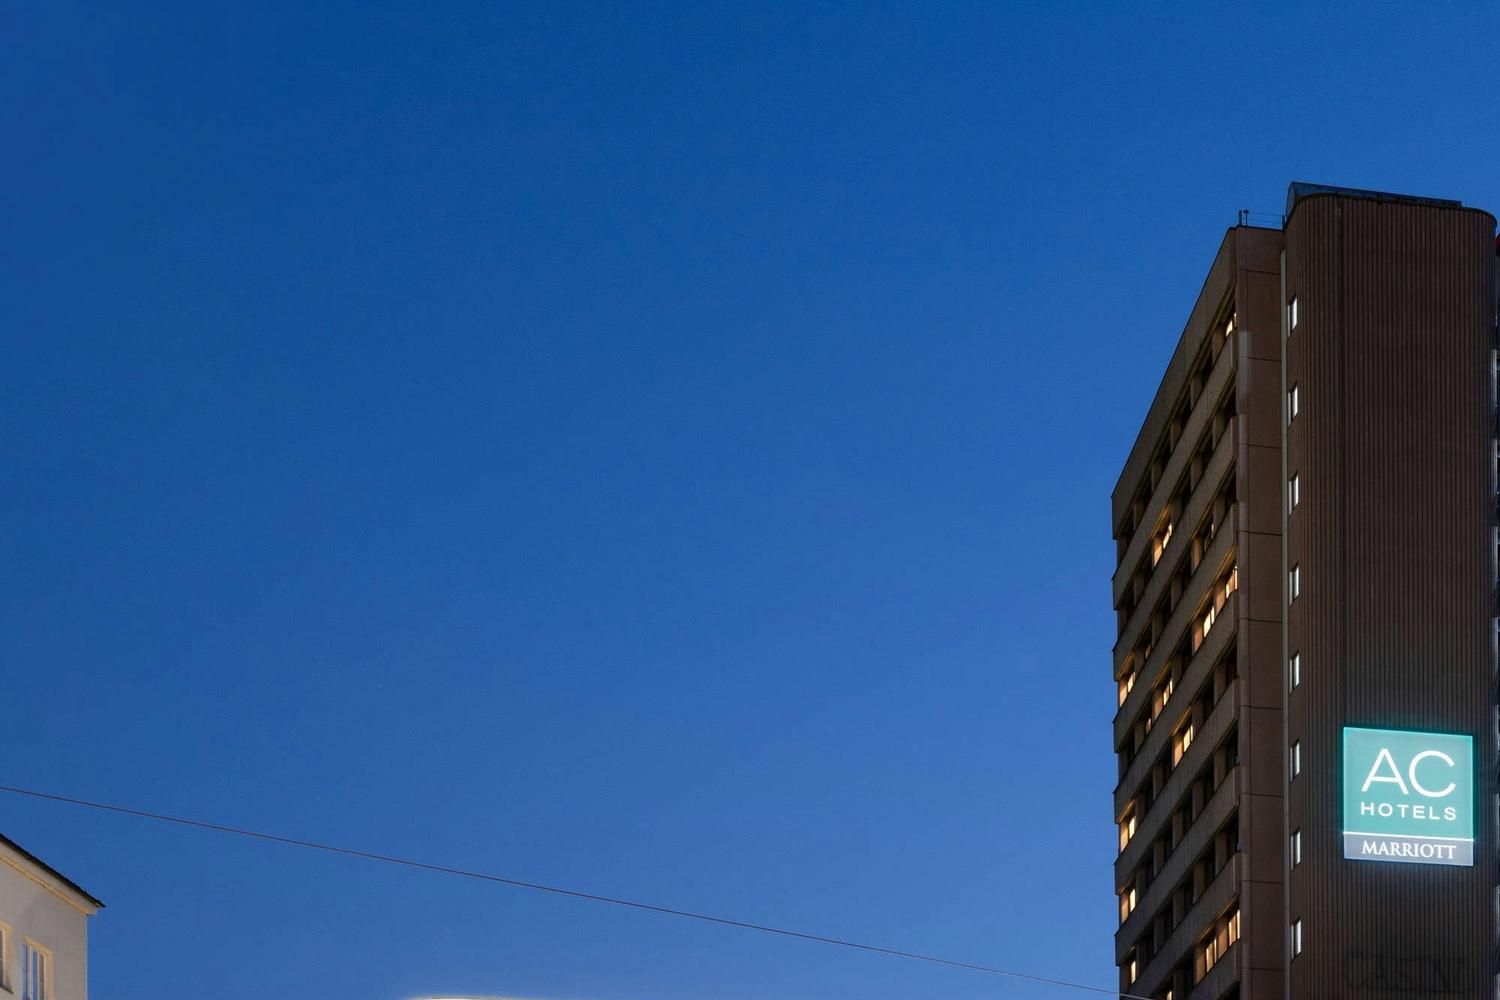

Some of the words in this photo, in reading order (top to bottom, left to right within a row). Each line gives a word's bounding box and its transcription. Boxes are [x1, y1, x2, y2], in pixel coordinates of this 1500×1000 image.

[1360, 748, 1457, 798] AC
[1360, 801, 1457, 821] HOTELS
[1361, 841, 1457, 860] MARRIOTT
